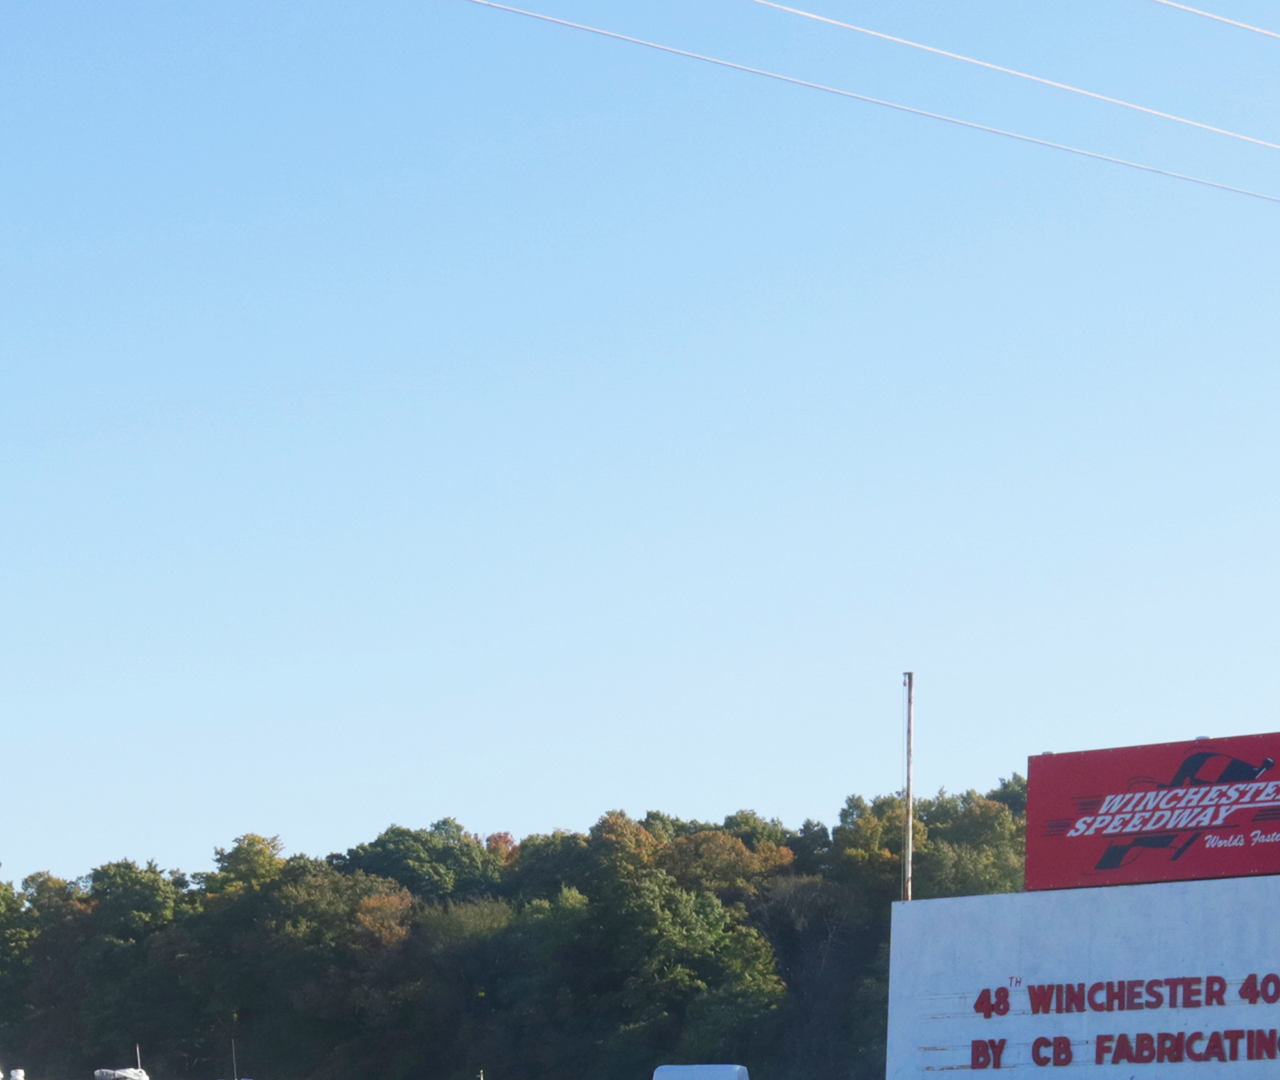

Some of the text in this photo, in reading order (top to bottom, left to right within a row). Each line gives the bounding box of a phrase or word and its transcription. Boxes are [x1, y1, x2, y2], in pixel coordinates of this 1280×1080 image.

[1067, 804, 1238, 837] SPEEDWAY
[1027, 976, 1228, 1015] WINCHESTER
[970, 1038, 1006, 1069] BY
[1032, 1036, 1073, 1067] CB
